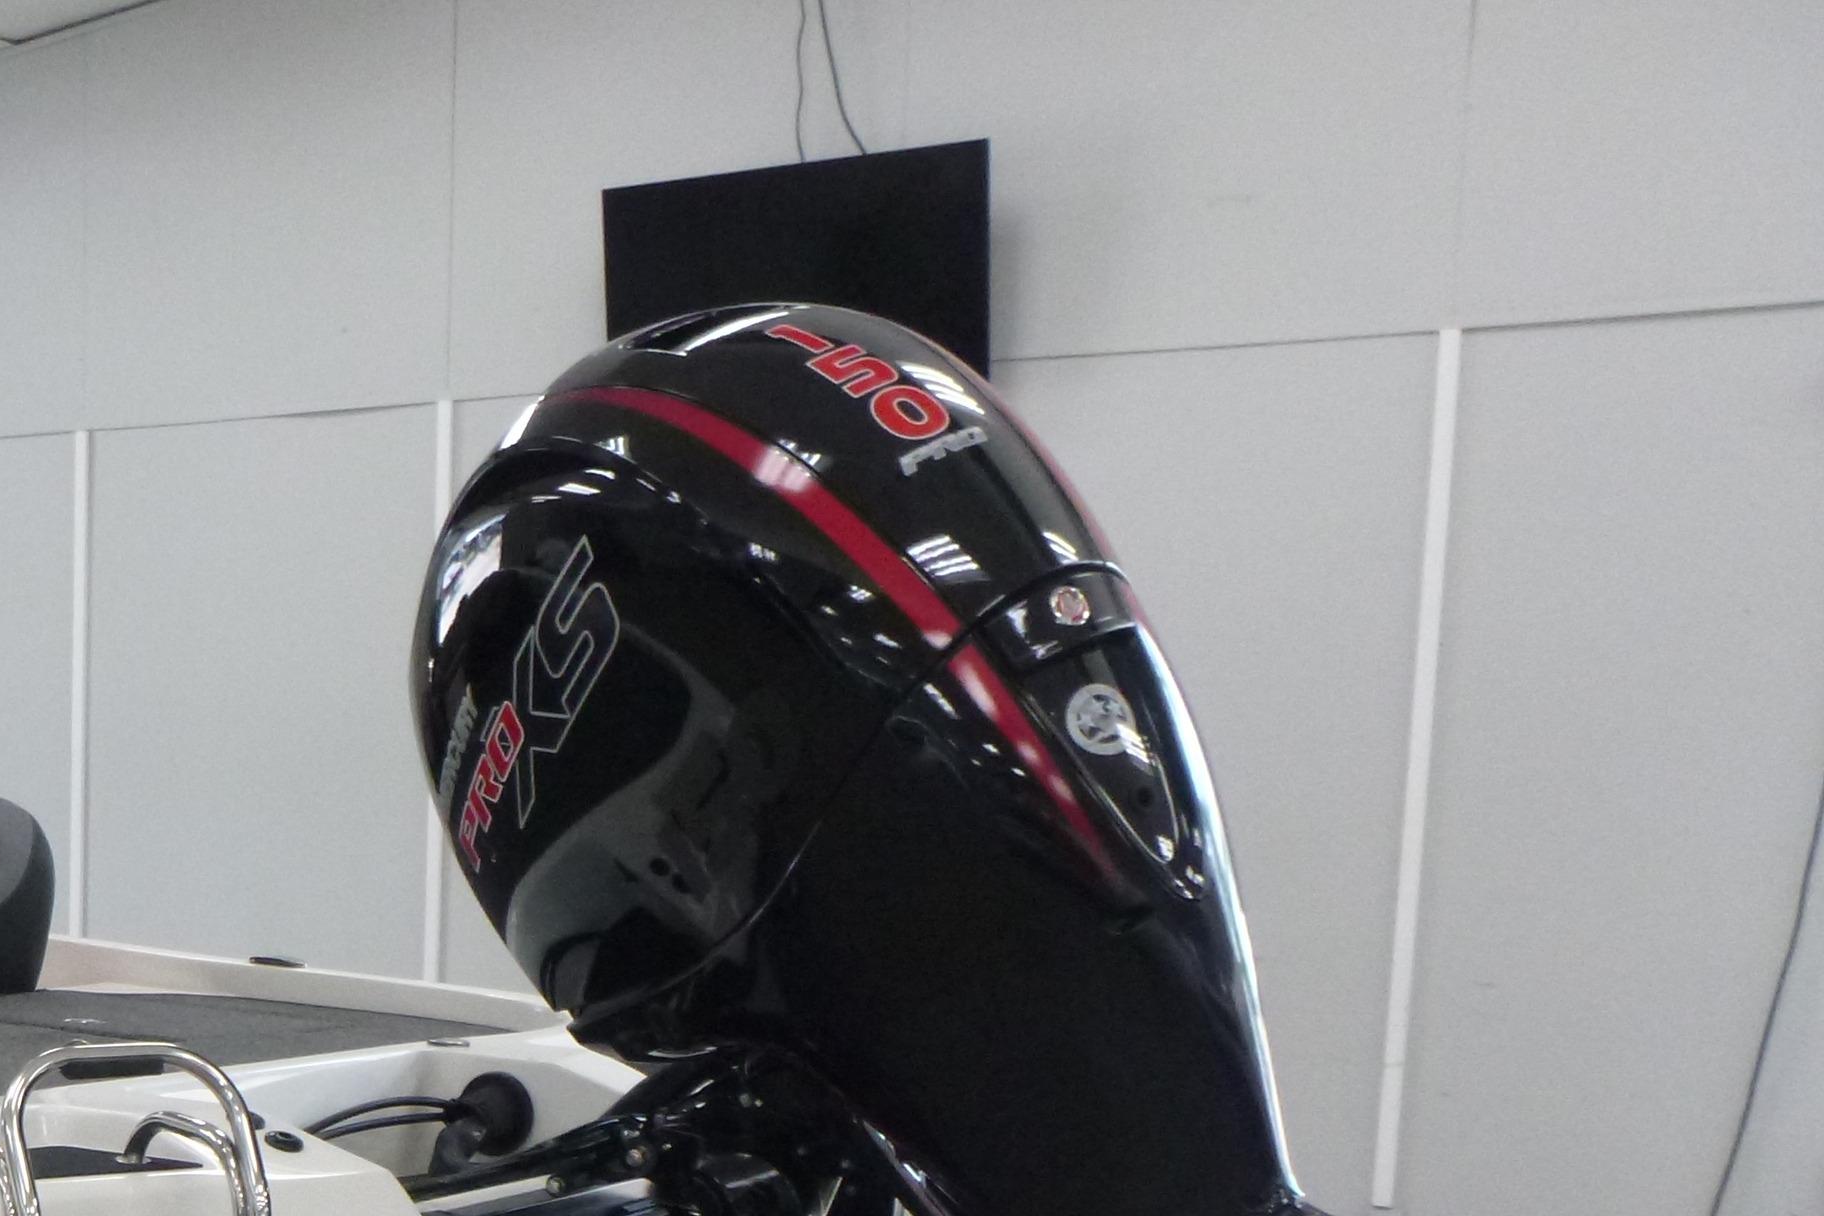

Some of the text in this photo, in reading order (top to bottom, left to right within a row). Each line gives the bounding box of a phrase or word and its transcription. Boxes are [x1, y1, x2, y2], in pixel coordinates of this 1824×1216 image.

[764, 324, 951, 440] 150
[458, 533, 621, 874] PRO XS
